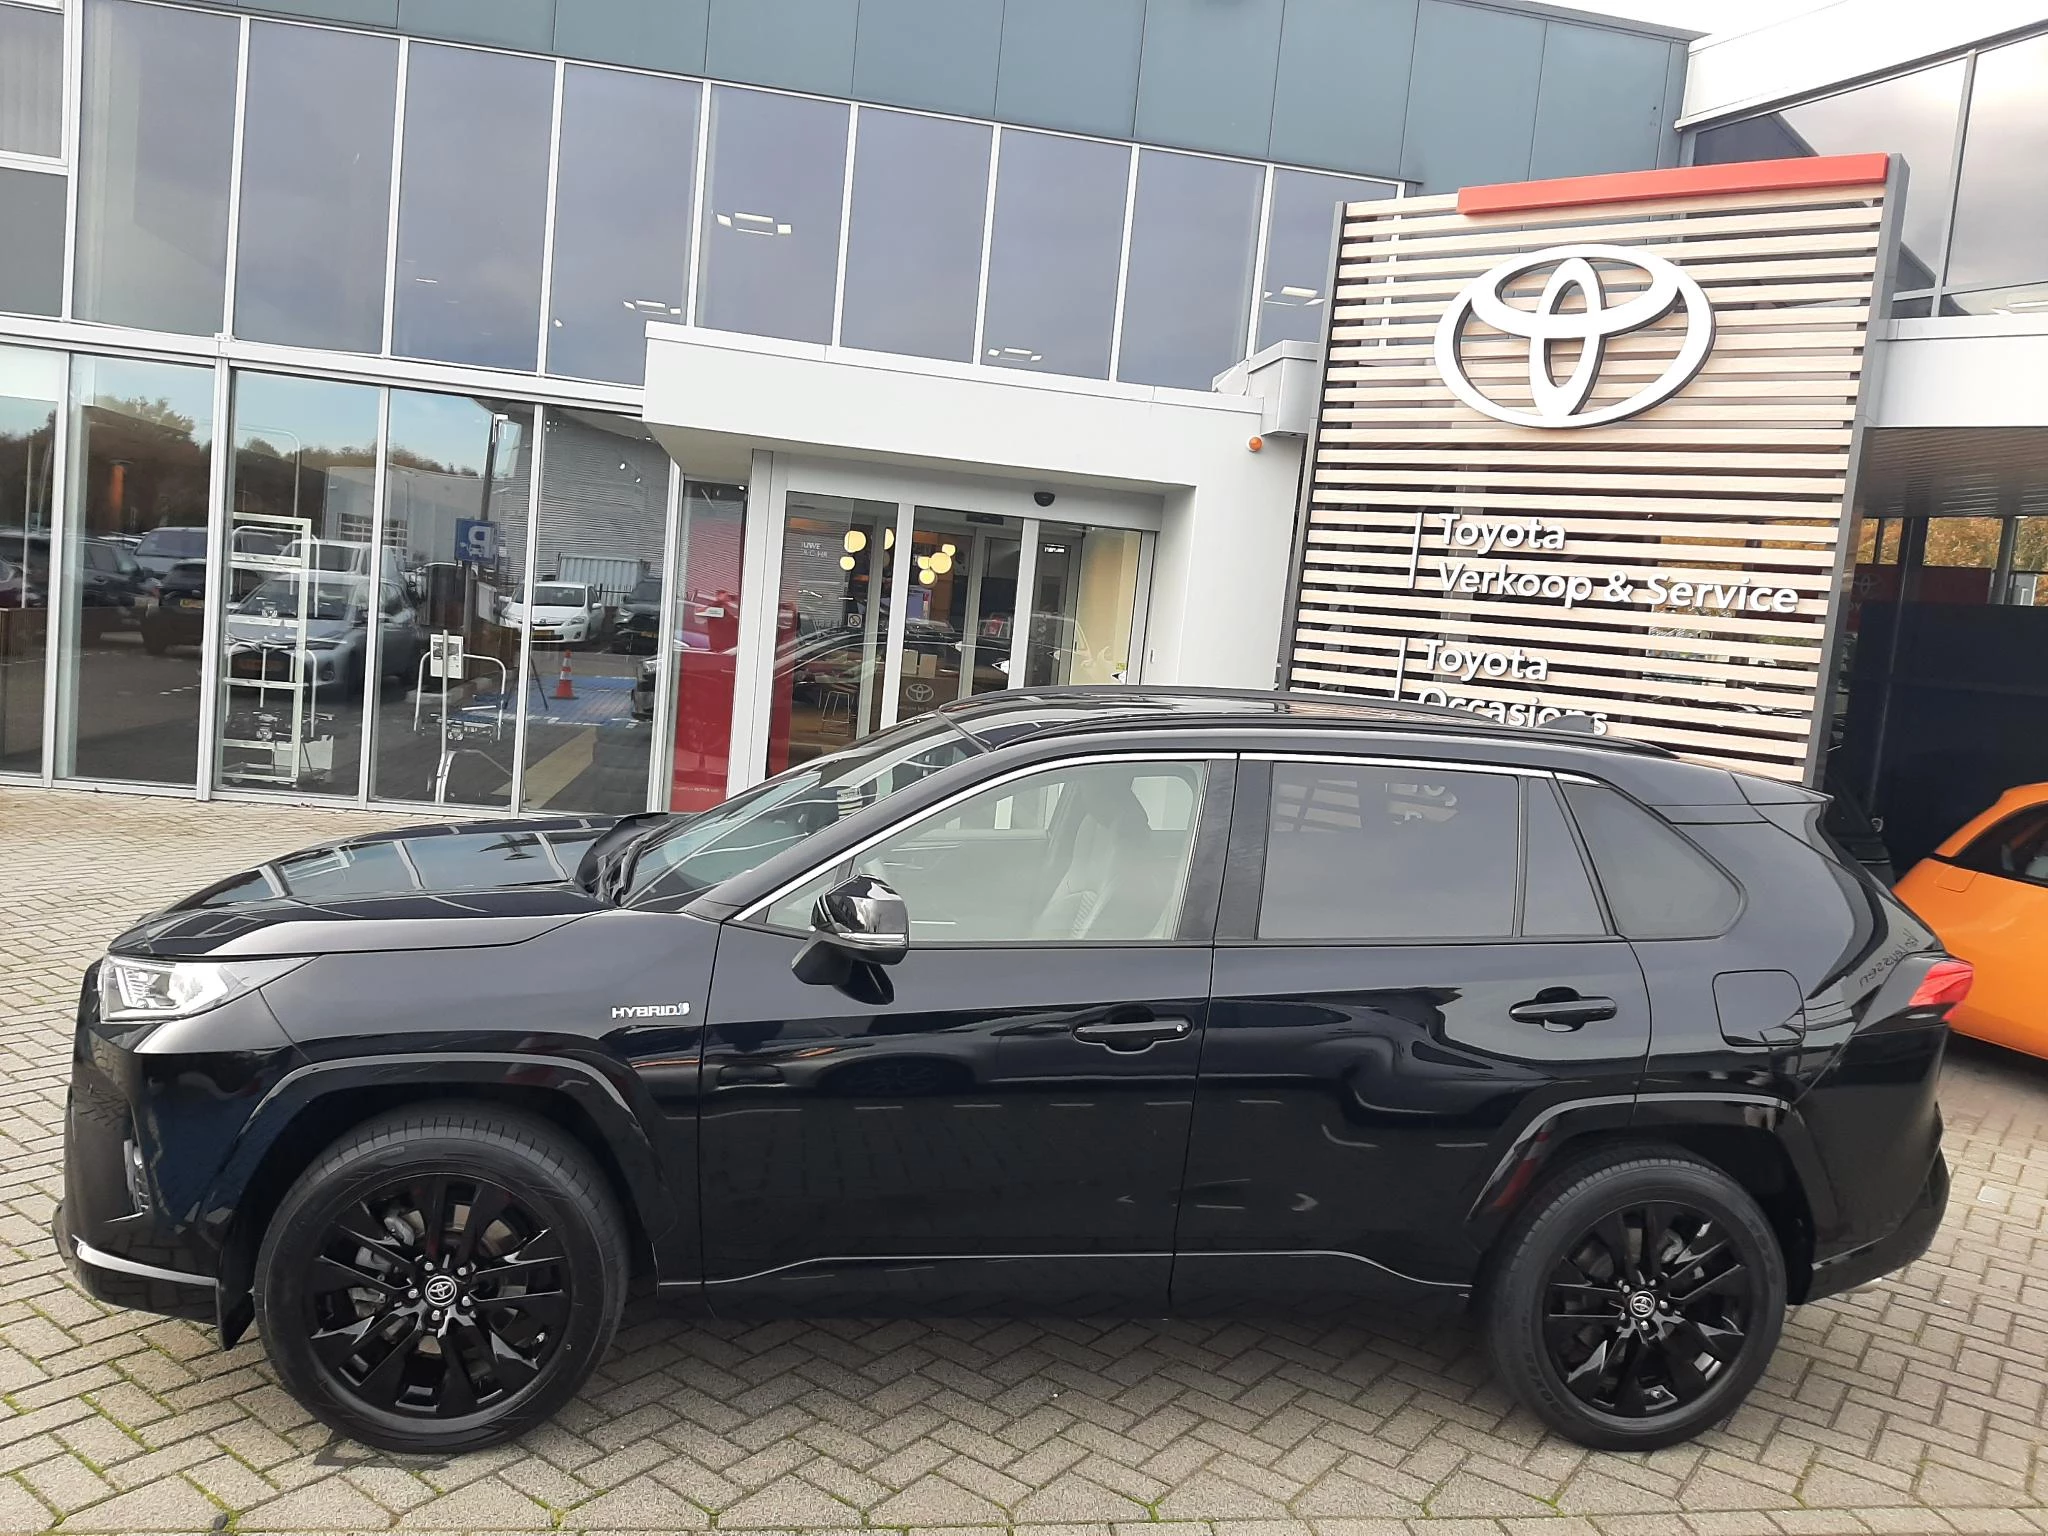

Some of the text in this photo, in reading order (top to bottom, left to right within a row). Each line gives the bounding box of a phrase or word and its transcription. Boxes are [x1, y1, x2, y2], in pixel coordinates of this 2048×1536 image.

[1438, 513, 1566, 555] Toyota
[1438, 562, 1800, 614] Verkoop & Service
[1424, 639, 1549, 682] Toyota
[1418, 687, 1608, 736] Ocasios
[611, 1005, 681, 1019] HYBRID
